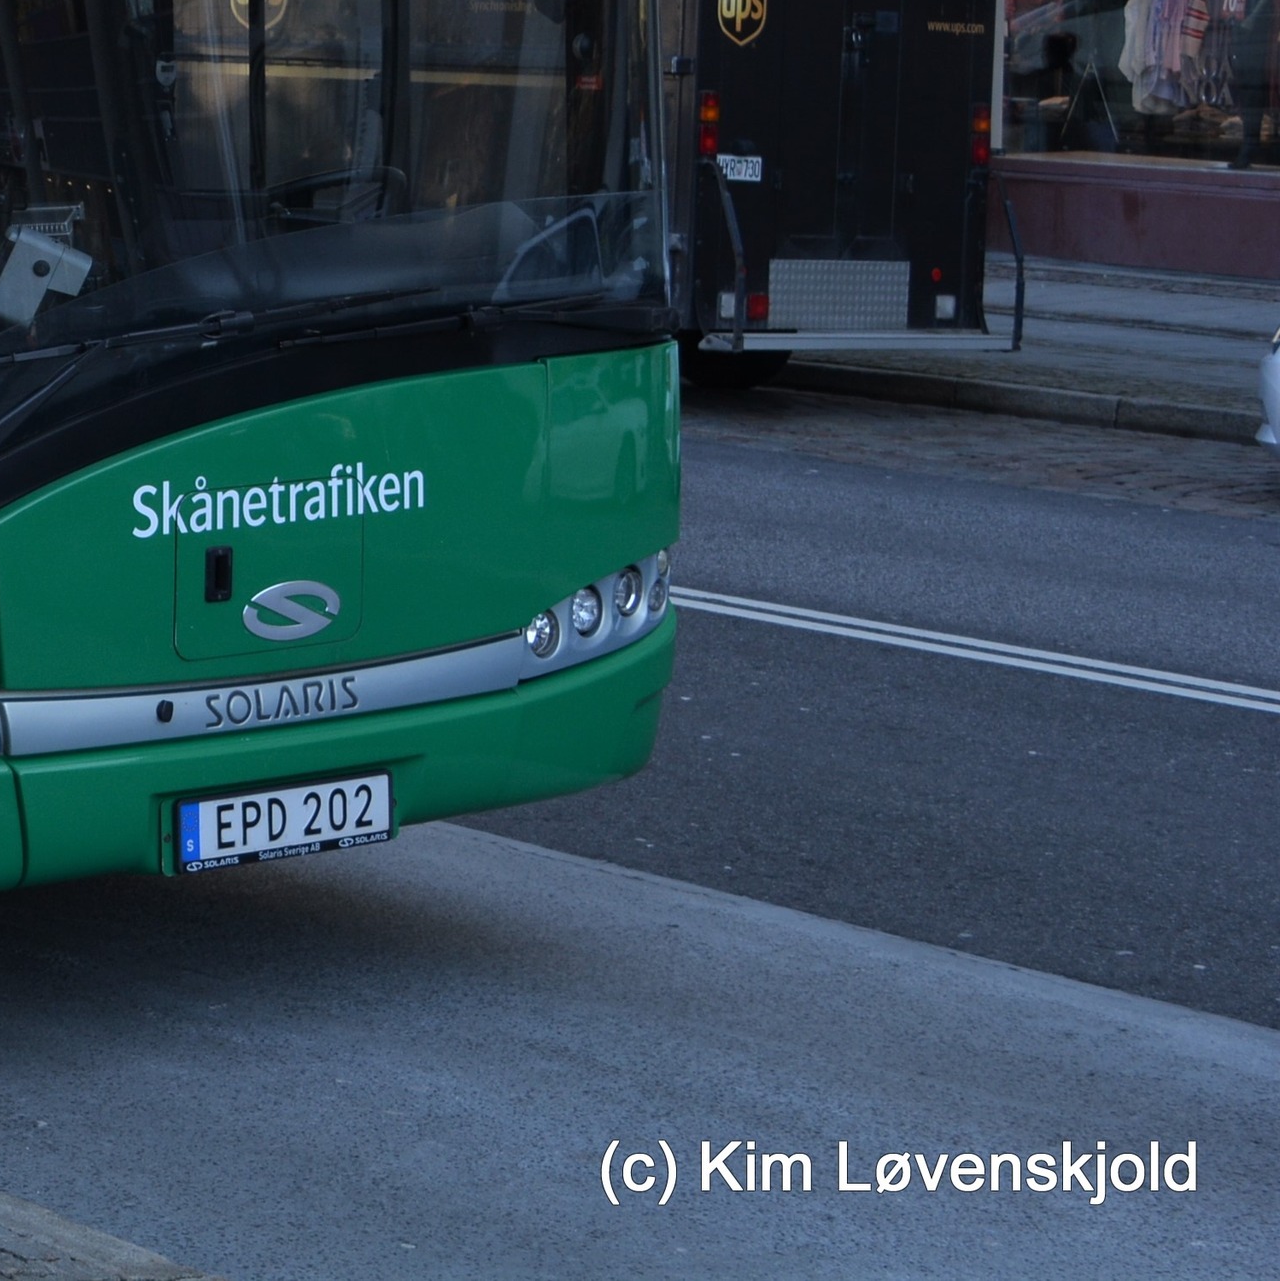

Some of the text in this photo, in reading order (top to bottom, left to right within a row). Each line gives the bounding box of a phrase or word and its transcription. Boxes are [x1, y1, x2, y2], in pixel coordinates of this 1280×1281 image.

[927, 20, 985, 36] www.ups.com
[743, 159, 760, 178] 730
[131, 461, 425, 538] Skånetrafiken
[205, 676, 359, 729] SOLARIS
[186, 784, 373, 852] S EPD 202
[354, 831, 388, 845] SOLARIS
[258, 842, 320, 860] Solaris Sverige AB
[203, 856, 240, 869] SOLARIS
